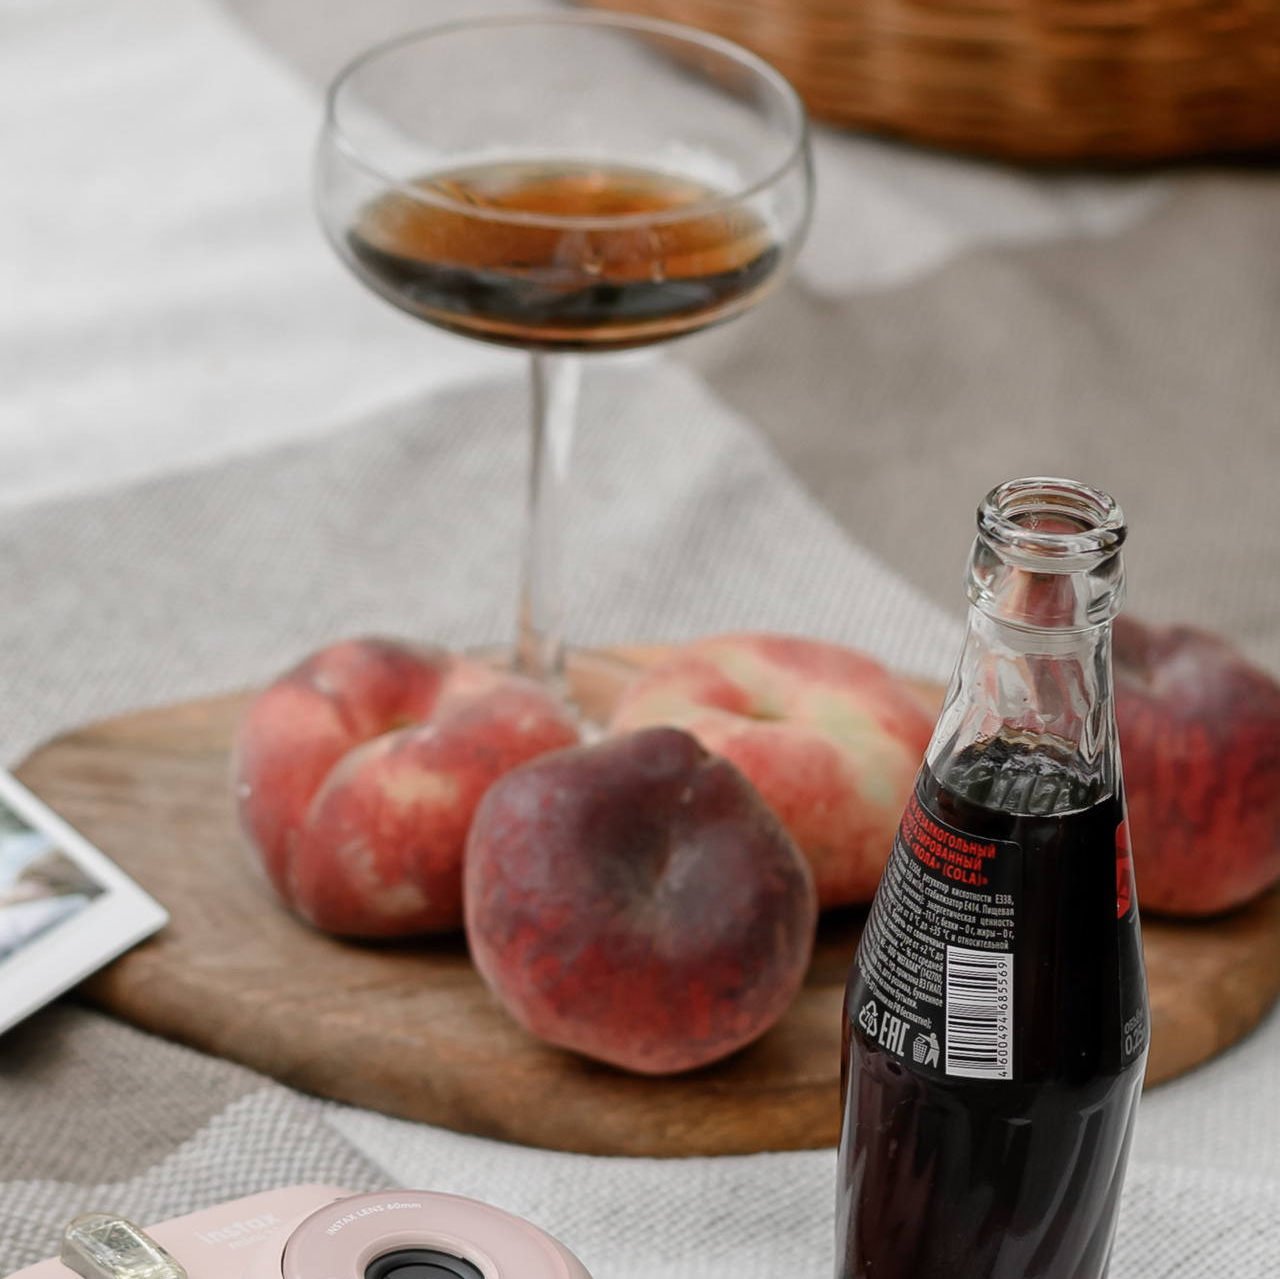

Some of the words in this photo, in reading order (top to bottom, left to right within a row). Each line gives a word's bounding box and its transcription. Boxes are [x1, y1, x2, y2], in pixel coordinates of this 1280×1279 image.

[924, 887, 963, 910] стабилизатор
[982, 903, 1014, 916] Пищевая
[951, 887, 991, 902] кислотности
[926, 900, 975, 923] энергетическая
[980, 917, 1014, 927] ценность
[957, 935, 1008, 949] относительной
[976, 928, 995, 938] жиры
[998, 962, 1008, 1010] 685569
[998, 1016, 1008, 1065] 600494
[193, 1214, 282, 1244] instax
[325, 1213, 358, 1236] INSTAX
[356, 1204, 385, 1217] LENS
[387, 1202, 422, 1210] 60mm
